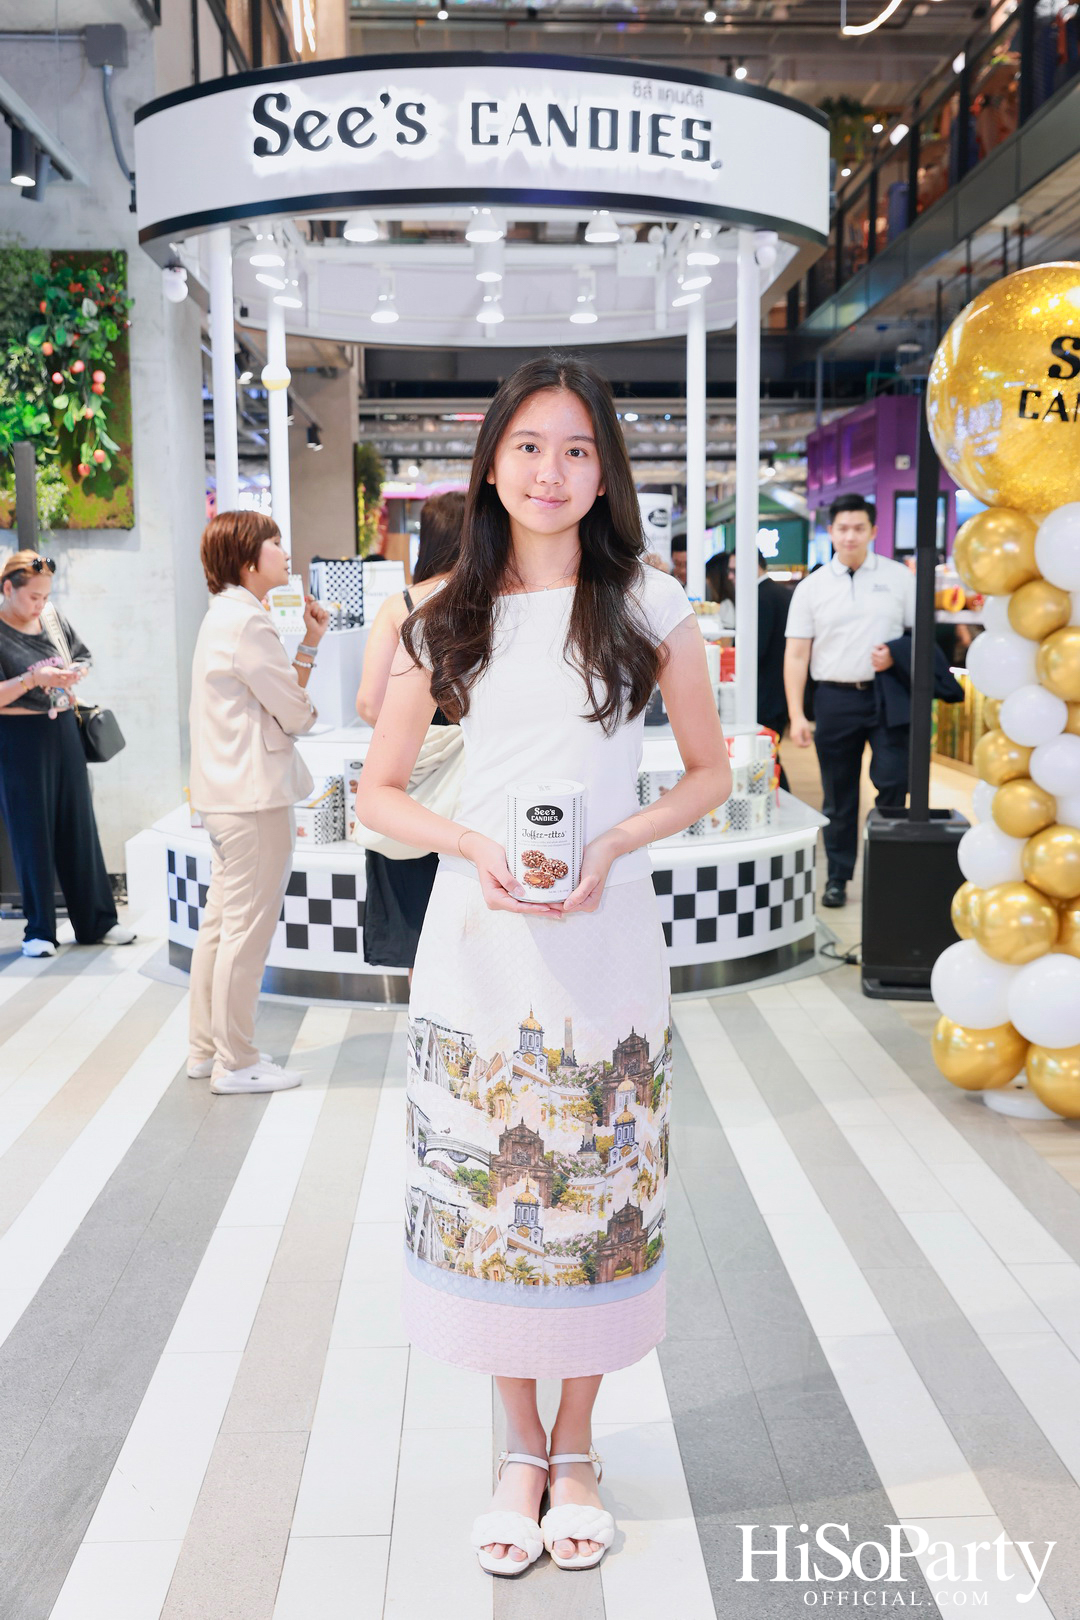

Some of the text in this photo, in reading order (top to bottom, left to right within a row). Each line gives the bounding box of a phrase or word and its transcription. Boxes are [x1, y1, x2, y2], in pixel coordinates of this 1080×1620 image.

[252, 92, 713, 163] See's CANDIES
[534, 807, 556, 816] See's
